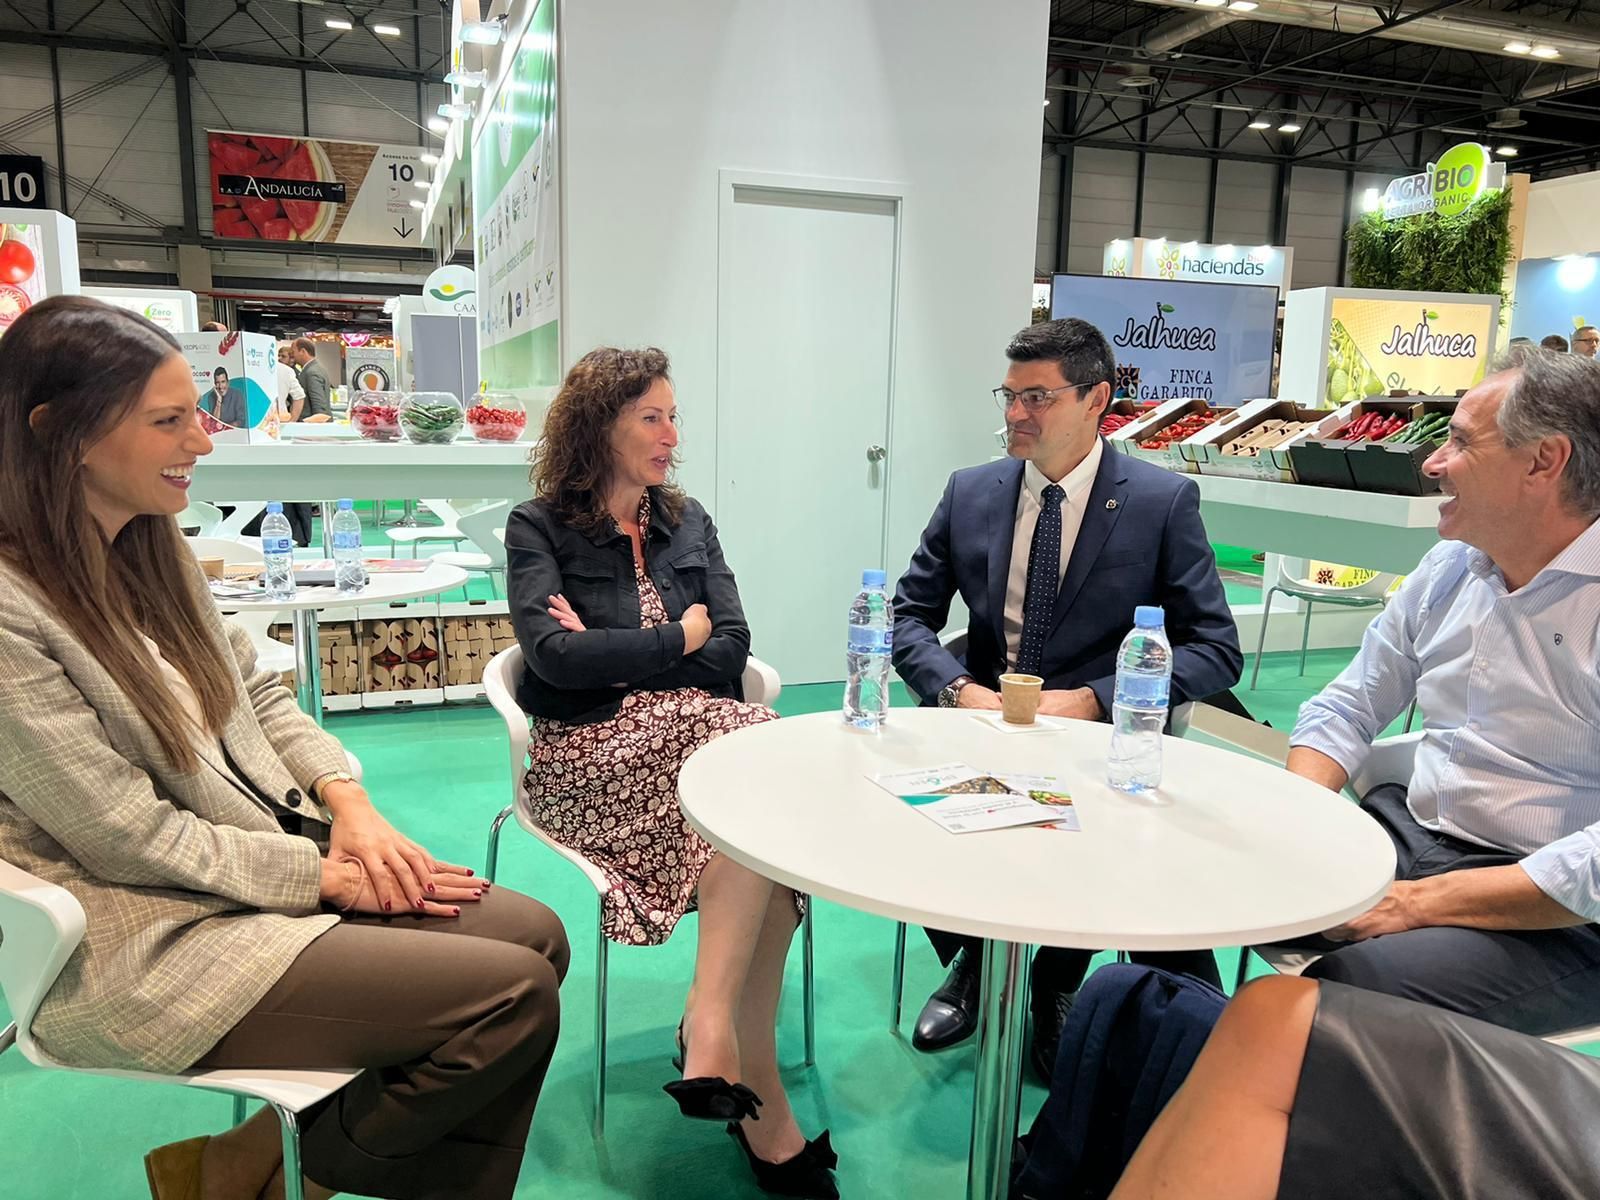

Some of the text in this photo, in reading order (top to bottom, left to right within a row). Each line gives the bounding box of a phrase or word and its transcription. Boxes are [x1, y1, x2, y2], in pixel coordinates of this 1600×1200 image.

[388, 163, 414, 182] 10
[0, 171, 37, 202] 10
[1182, 255, 1265, 276] haciendas
[151, 308, 172, 316] Zero
[453, 302, 476, 313] CAA
[1113, 315, 1216, 351] Jalhuca
[1381, 323, 1476, 358] Jalhuca
[1169, 368, 1213, 385] FINCA
[1140, 385, 1213, 400] GARABITO
[1353, 569, 1375, 580] FINC
